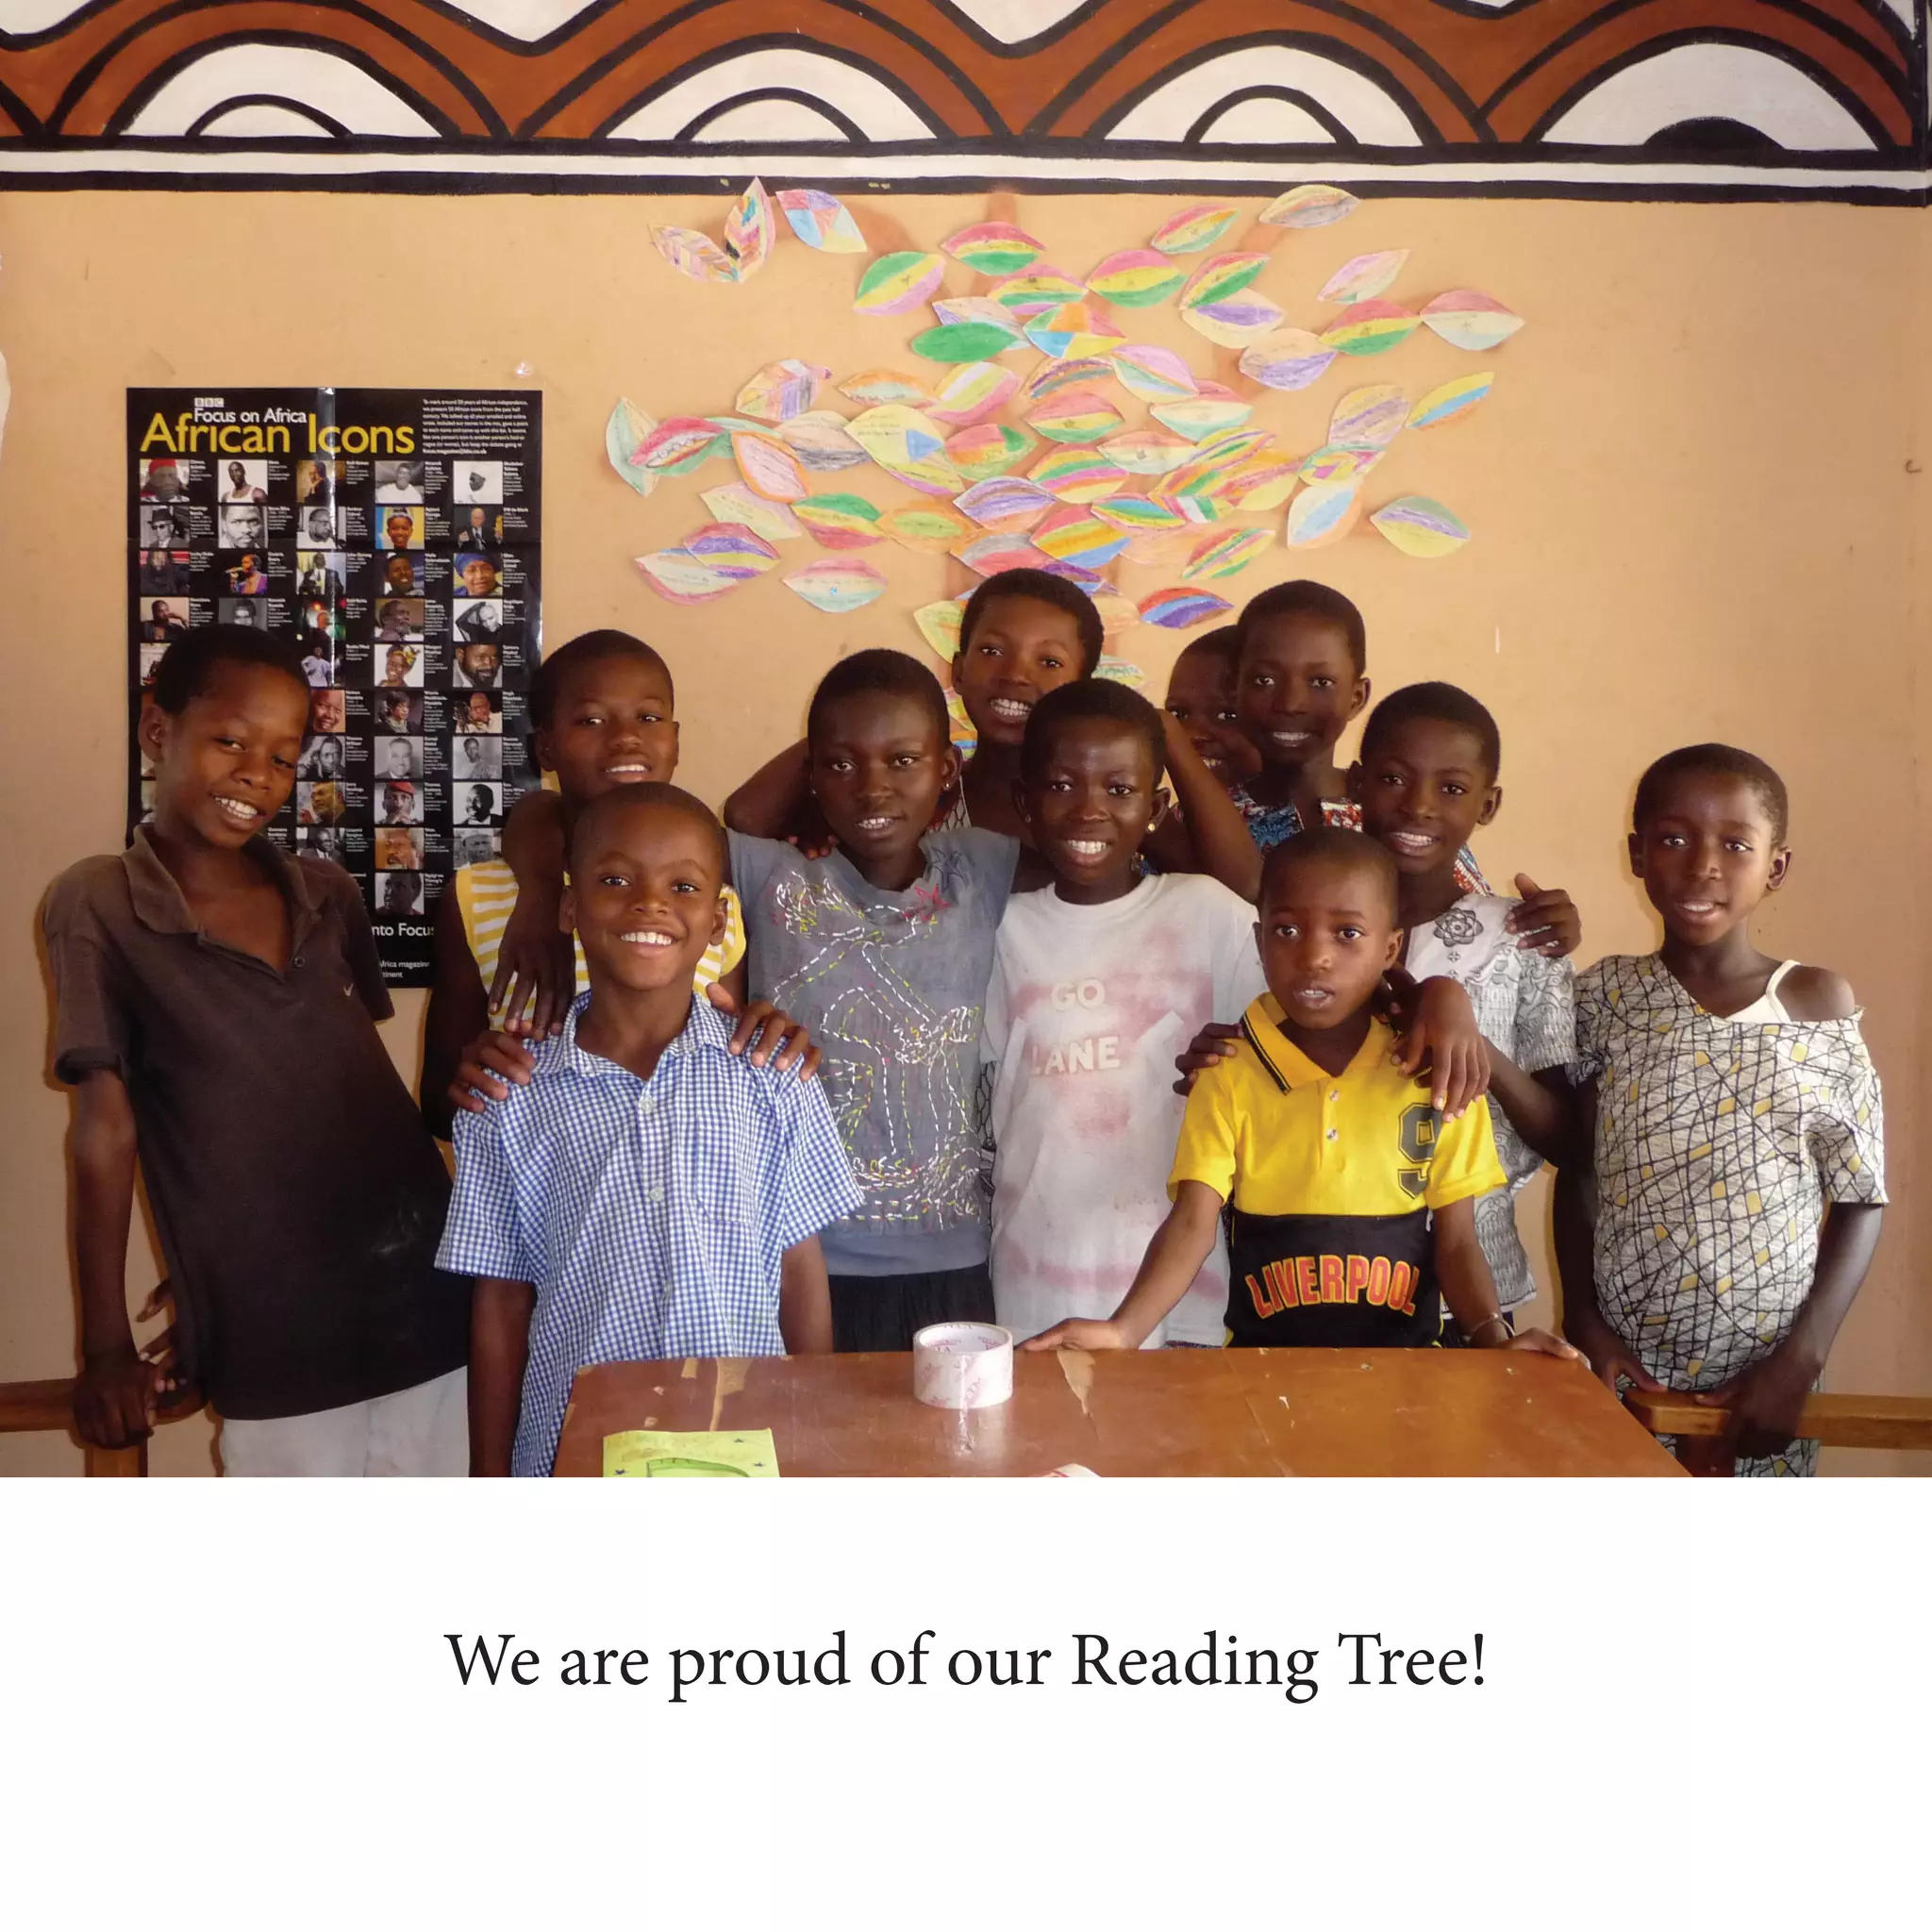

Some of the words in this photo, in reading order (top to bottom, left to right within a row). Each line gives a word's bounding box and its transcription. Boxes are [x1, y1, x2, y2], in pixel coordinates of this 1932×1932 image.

[140, 412, 291, 453] African
[308, 413, 415, 454] Icons
[194, 408, 236, 423] Focus
[241, 411, 259, 423] on
[263, 408, 307, 424] Africa
[371, 925, 394, 936] nto
[1050, 978, 1106, 1012] GO
[1397, 1101, 1445, 1201] 9
[1244, 1254, 1421, 1320] LIVERPOOL
